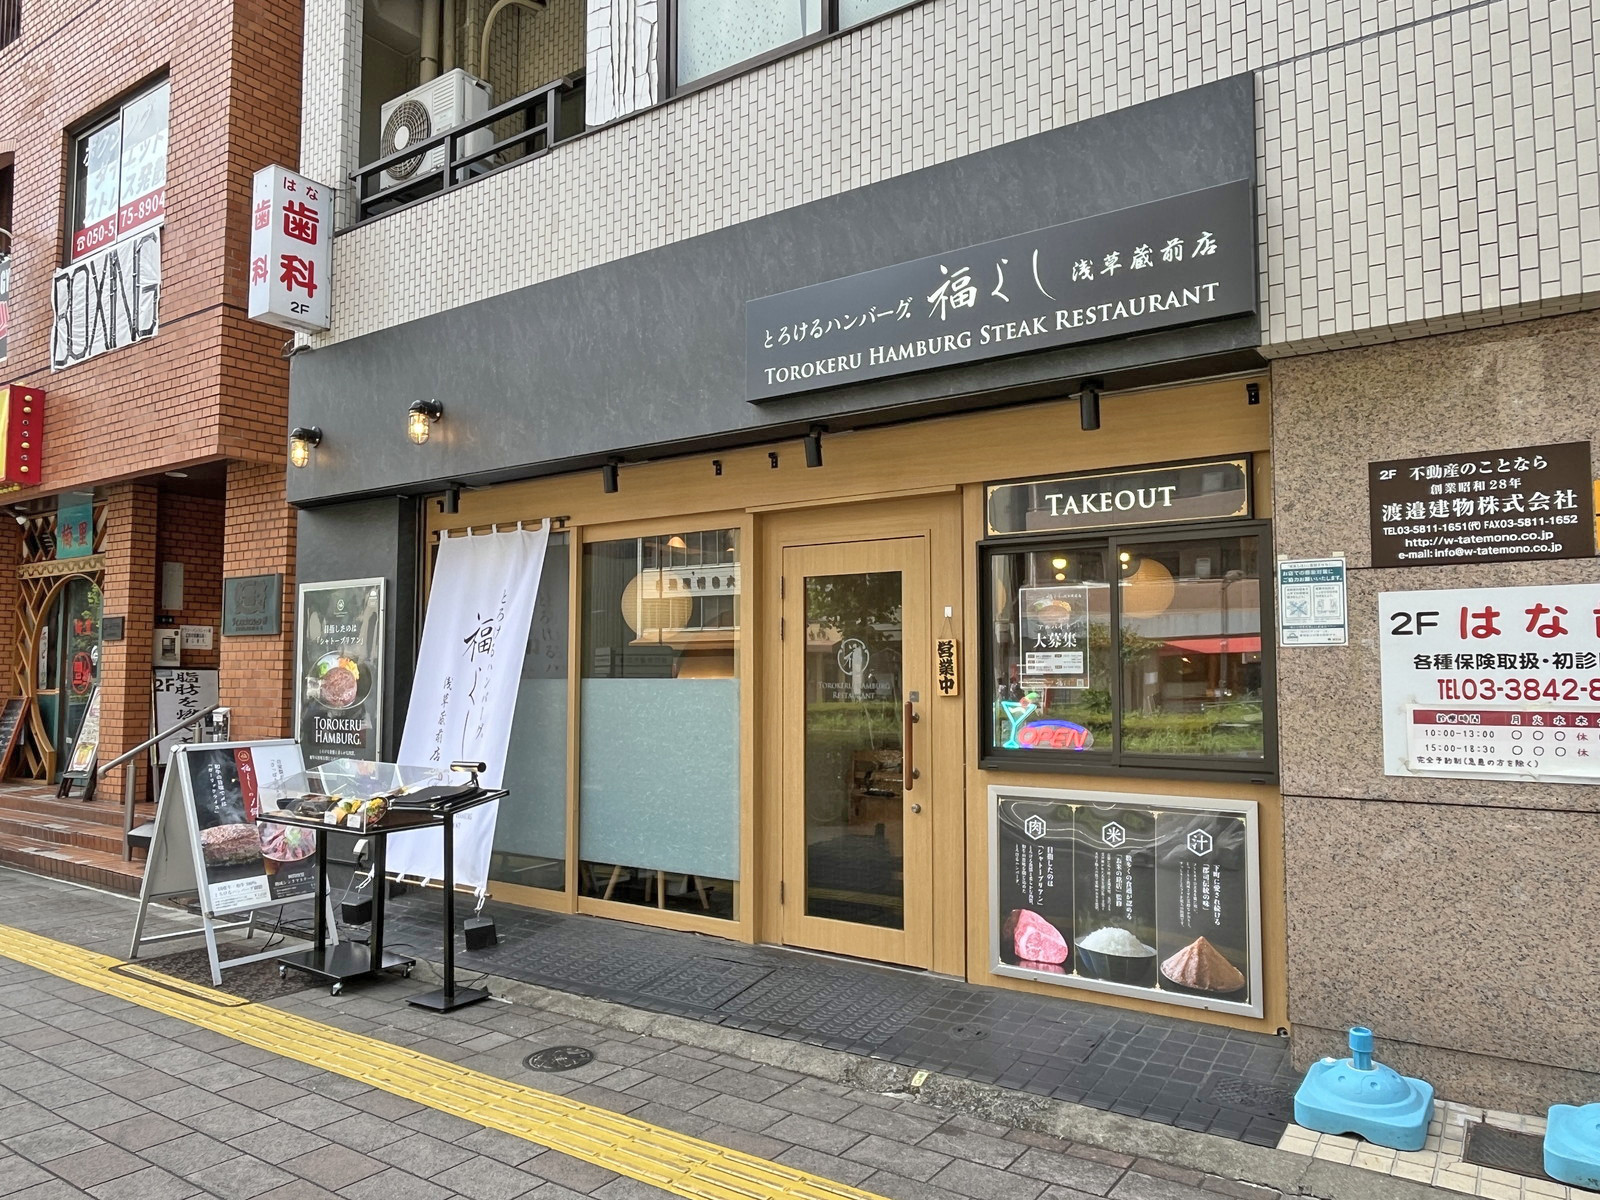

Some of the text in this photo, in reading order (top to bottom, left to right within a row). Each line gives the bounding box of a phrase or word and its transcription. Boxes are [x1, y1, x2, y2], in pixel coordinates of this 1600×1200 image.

[283, 177, 319, 201] はな
[252, 199, 271, 286] 歯科
[280, 200, 320, 299] 歯科
[1072, 231, 1218, 282] 浅草蔵前店
[54, 232, 158, 366] BOXING
[290, 301, 310, 314] 2F
[764, 282, 1219, 384] TOROKERU HAMBURG STEAK RESTAURANT
[1379, 455, 1548, 481] 2F 不動産のことなら
[1045, 486, 1176, 516] TAKEOUT
[1484, 515, 1578, 530] FAX03-5811-1652
[1405, 530, 1554, 547] http://w-tatemono.co.jp
[323, 624, 357, 634] 目指したのは
[1390, 603, 1600, 640] 2F はな
[1033, 632, 1077, 648] 大募集
[937, 640, 955, 694] 営業中
[1413, 652, 1600, 671] 各種保険取扱・初診
[155, 678, 175, 692] 2F
[314, 716, 362, 732] TOROKERU
[429, 676, 453, 762] 浅草蔵前店
[1436, 713, 1588, 727] 診療時間 月 火 水 木
[1018, 726, 1088, 748] OPEN
[1576, 732, 1589, 741] 休
[1577, 748, 1589, 757] 休
[1028, 820, 1042, 835] 肉
[1106, 826, 1122, 843] 米
[1191, 834, 1209, 851] 汁
[1046, 846, 1054, 887] 目指したのは
